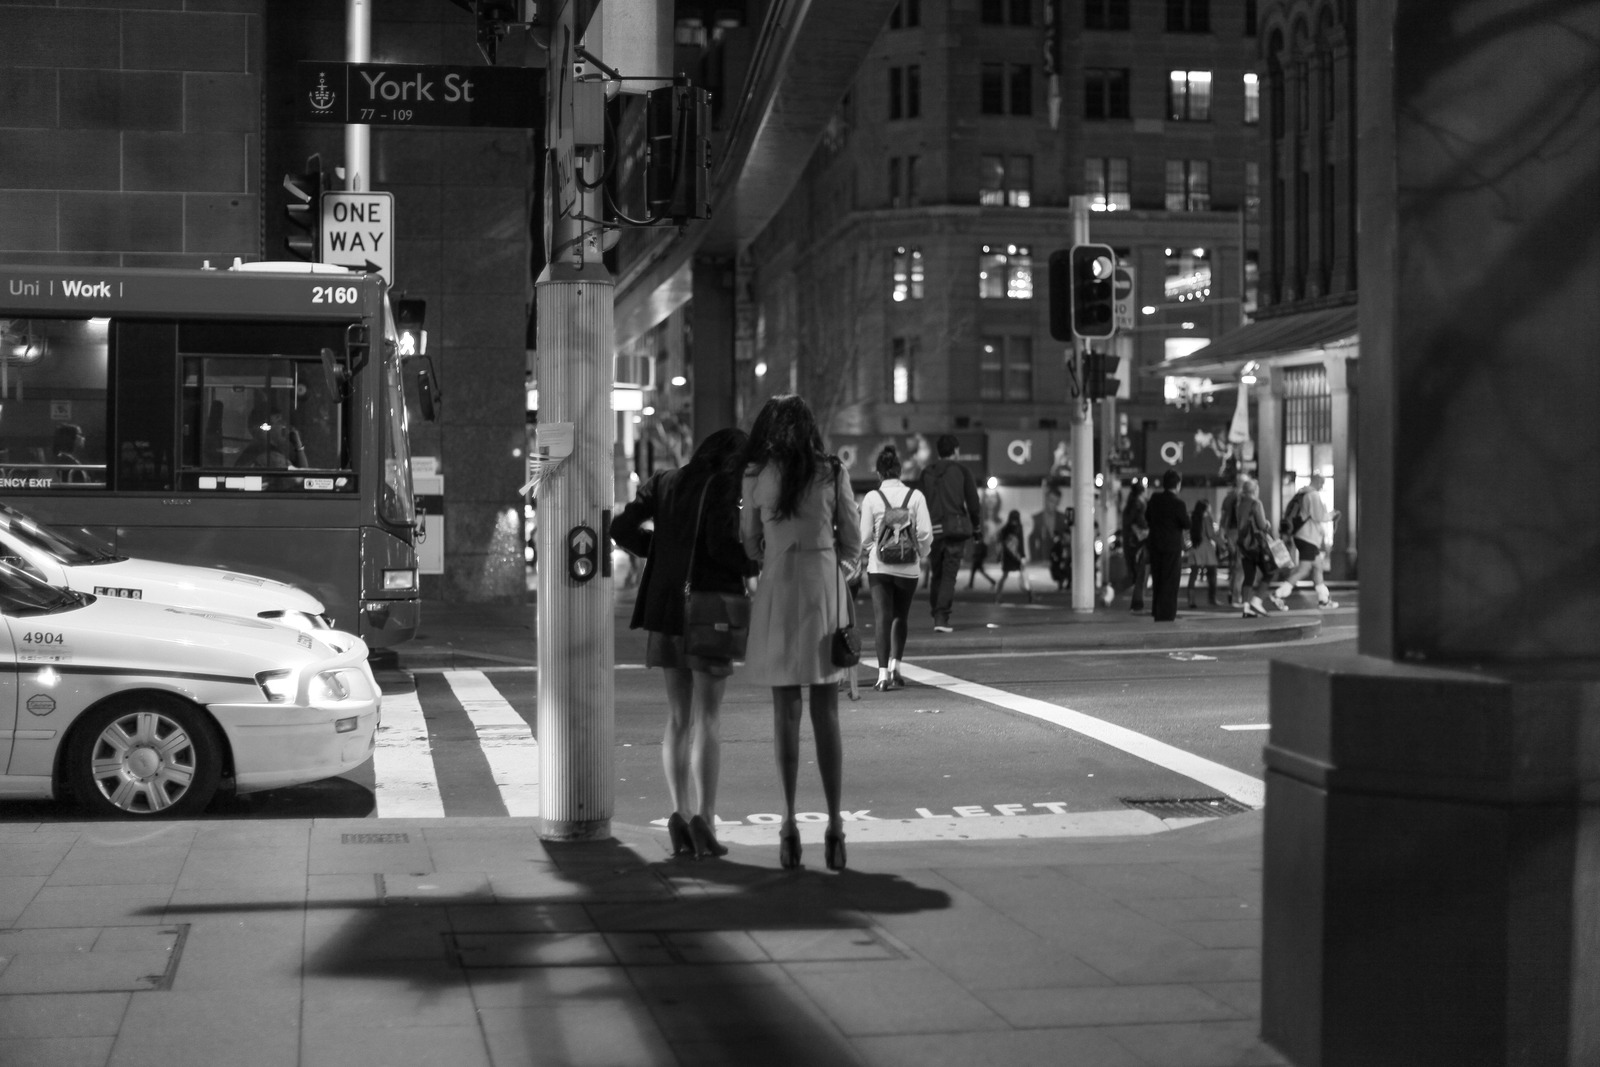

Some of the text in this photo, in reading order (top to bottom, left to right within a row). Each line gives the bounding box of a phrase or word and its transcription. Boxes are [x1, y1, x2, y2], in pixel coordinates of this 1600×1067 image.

[360, 71, 475, 102] York St
[360, 109, 375, 120] 77
[393, 109, 413, 121] 109
[333, 202, 381, 223] ONE
[329, 231, 384, 252] WAY
[9, 280, 111, 298] Uni Work
[312, 286, 358, 304] 2160
[29, 478, 52, 488] EXIT
[23, 632, 64, 645] 4904
[713, 802, 1067, 826] LOOK LEFT
